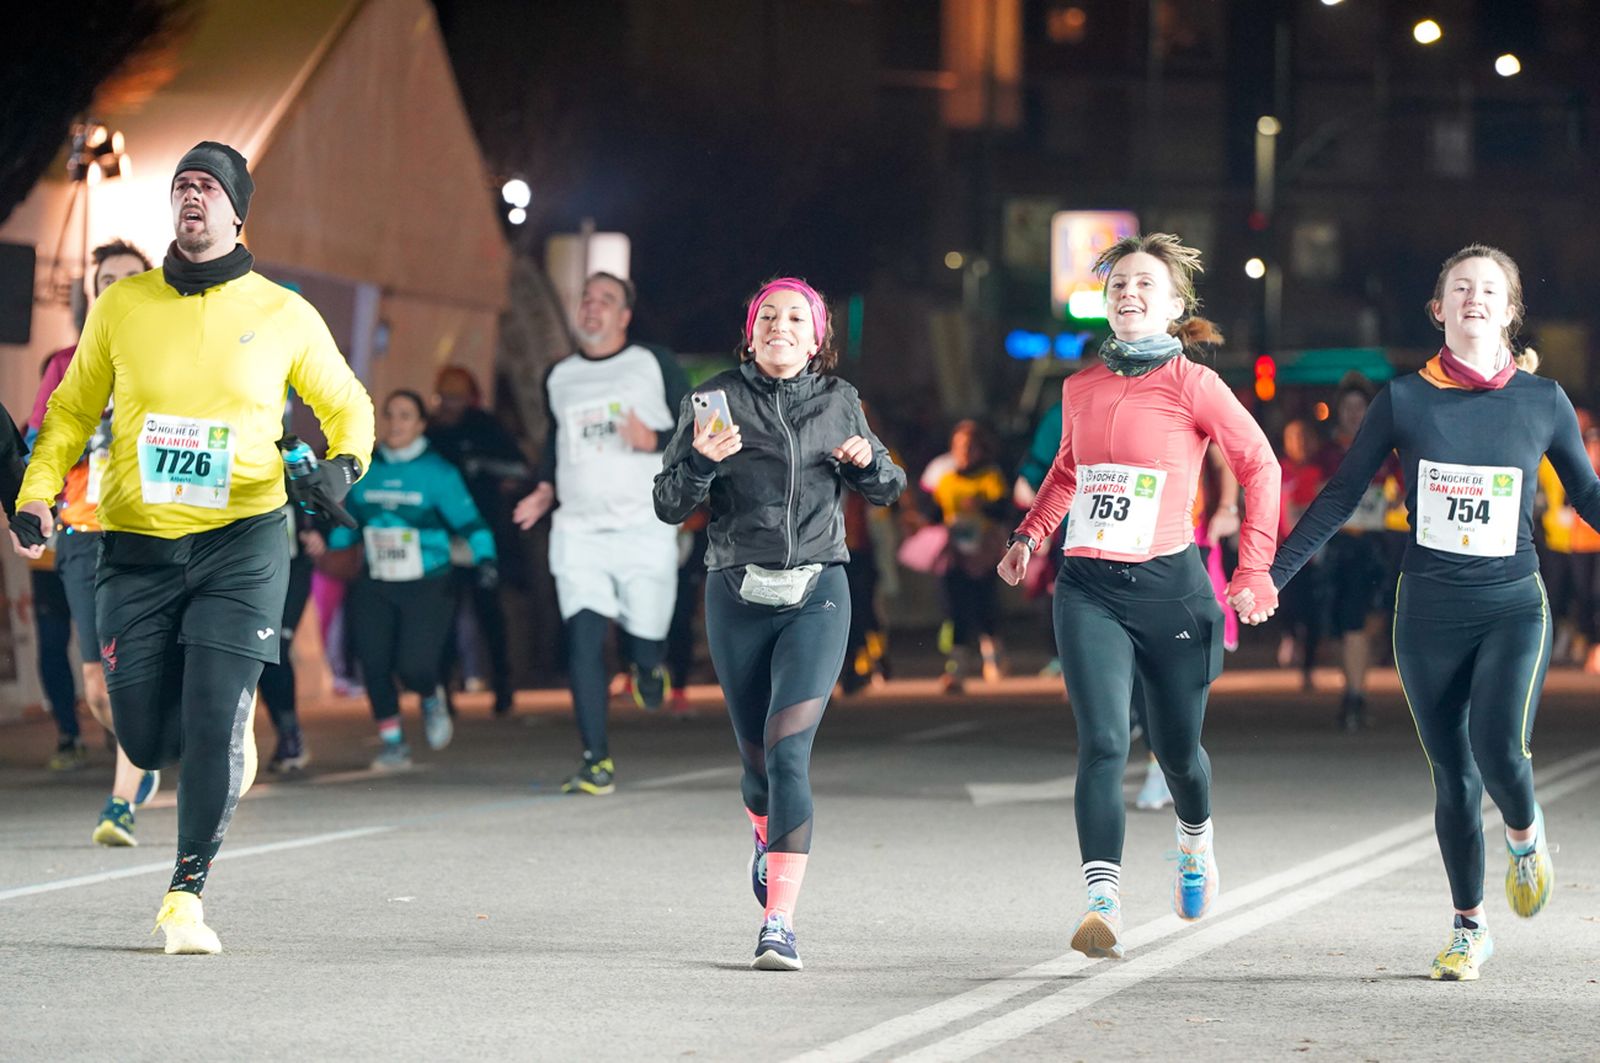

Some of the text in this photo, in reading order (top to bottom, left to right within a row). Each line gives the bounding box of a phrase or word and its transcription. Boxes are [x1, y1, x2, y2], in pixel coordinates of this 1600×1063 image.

[158, 426, 188, 436] NOCHE
[188, 428, 200, 437] DE
[145, 435, 165, 446] SAN
[167, 435, 200, 448] ANTÓN
[156, 448, 212, 477] 7726
[1117, 475, 1129, 483] DE
[1441, 474, 1471, 484] NOCHE
[1472, 476, 1484, 485] DE
[1429, 483, 1448, 493] SAN
[1449, 484, 1484, 496] ANTÓN
[1089, 494, 1131, 521] 753
[1446, 496, 1490, 525] 754
